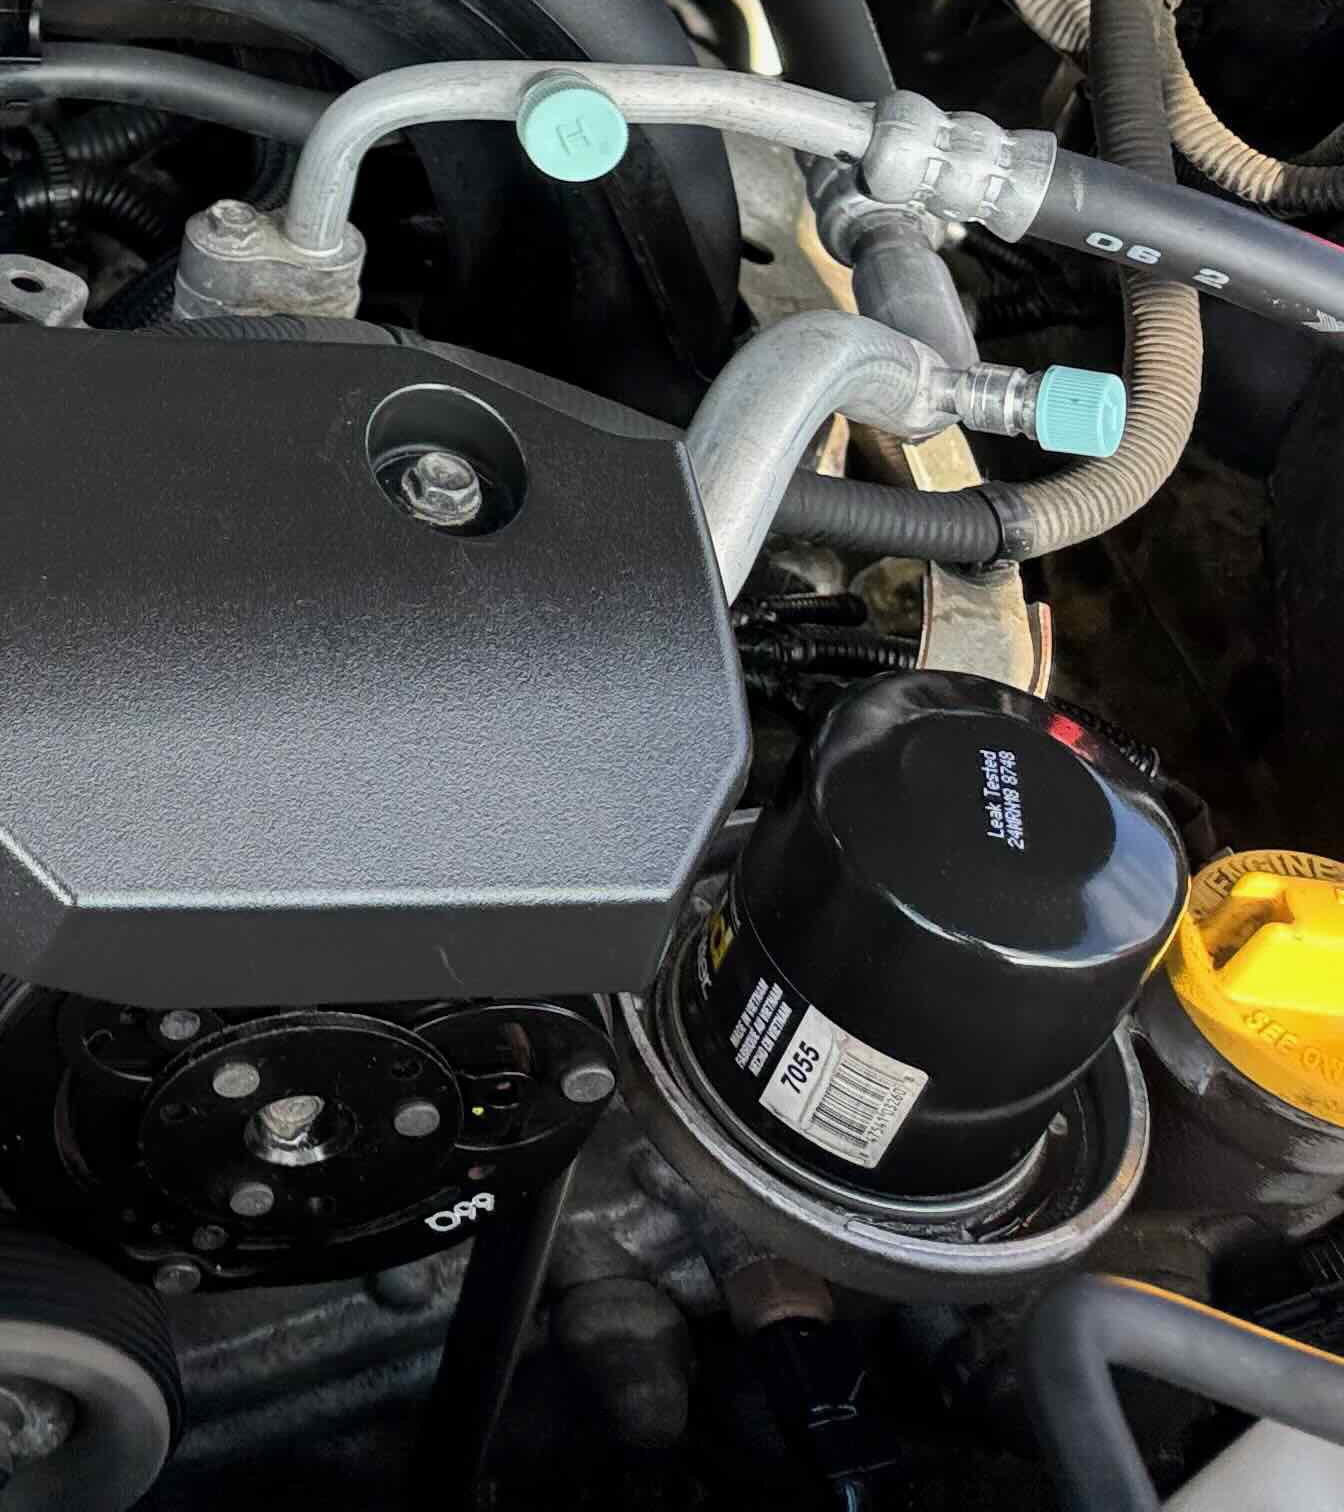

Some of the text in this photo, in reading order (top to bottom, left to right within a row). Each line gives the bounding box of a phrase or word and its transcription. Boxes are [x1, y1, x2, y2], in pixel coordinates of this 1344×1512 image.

[1192, 268, 1230, 289] 2
[998, 750, 1018, 786] 8748
[978, 749, 1005, 839] Leak Tested
[1203, 853, 1341, 899] ENGINE
[745, 977, 769, 1018] VIETNAM
[758, 982, 783, 1023] VIETNAM
[767, 1000, 793, 1041] VIETNAM
[1243, 1009, 1297, 1054] SEE
[780, 1040, 820, 1094] 7055
